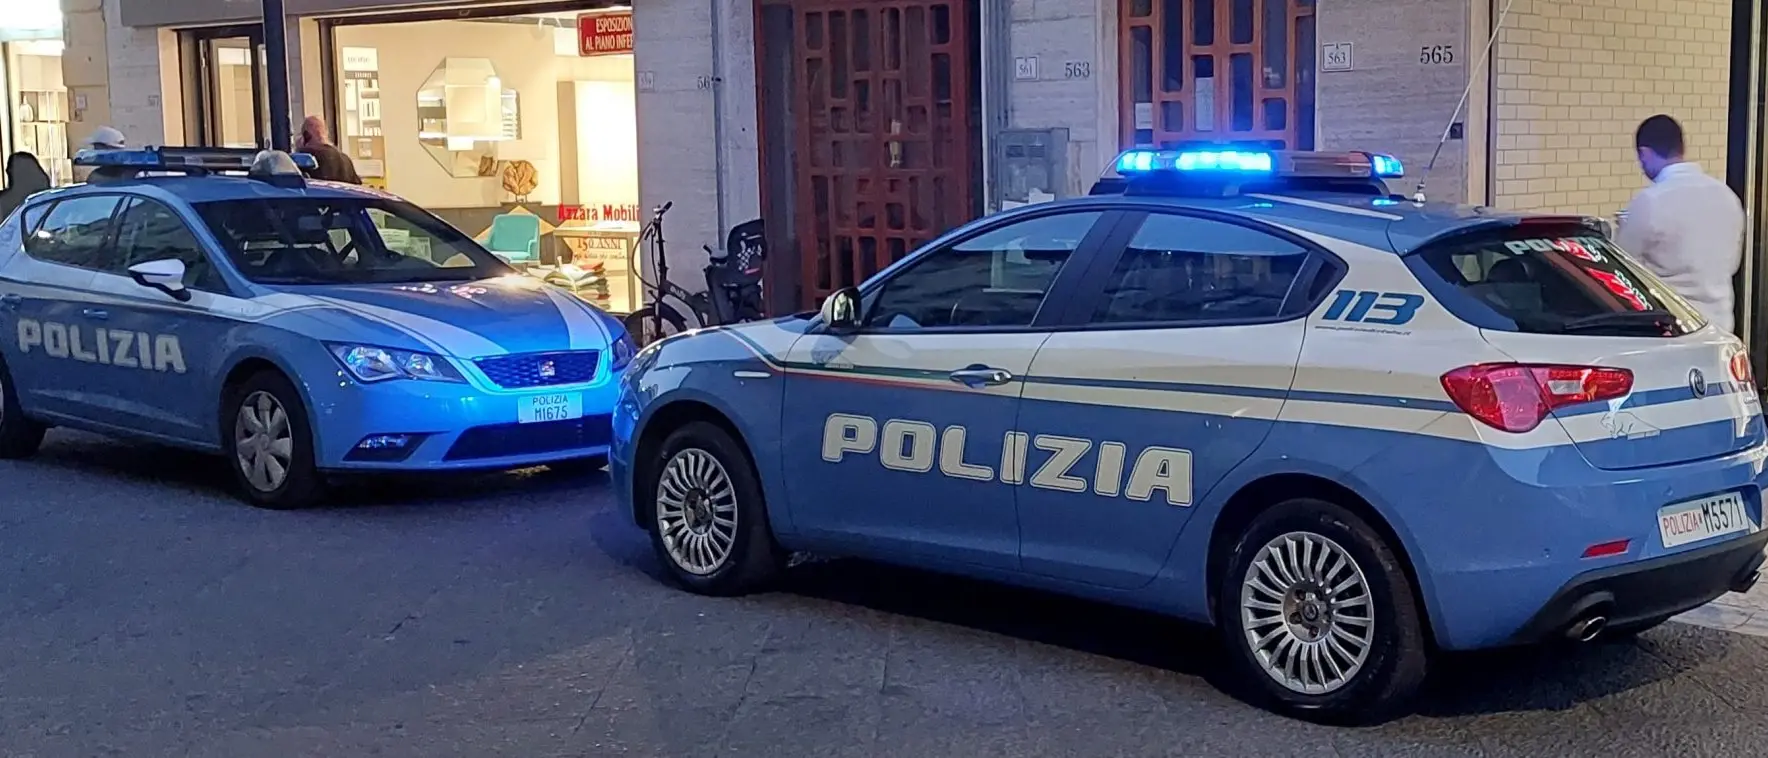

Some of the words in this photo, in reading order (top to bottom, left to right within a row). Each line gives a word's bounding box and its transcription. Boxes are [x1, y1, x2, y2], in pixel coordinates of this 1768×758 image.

[585, 36, 594, 51] AL
[594, 34, 615, 51] PIANO
[615, 33, 633, 49] INFE
[1328, 52, 1346, 65] 563
[1420, 45, 1453, 64] 565
[1064, 61, 1090, 79] 563
[603, 204, 640, 222] Mobili
[577, 238, 594, 251] 150
[1321, 289, 1425, 326] 113
[17, 317, 187, 374] POLIZIA
[533, 395, 569, 406] POLIZIA
[822, 412, 1193, 507] POLIZIA
[1662, 511, 1700, 538] POLIZIA
[1701, 496, 1743, 534] M5571
